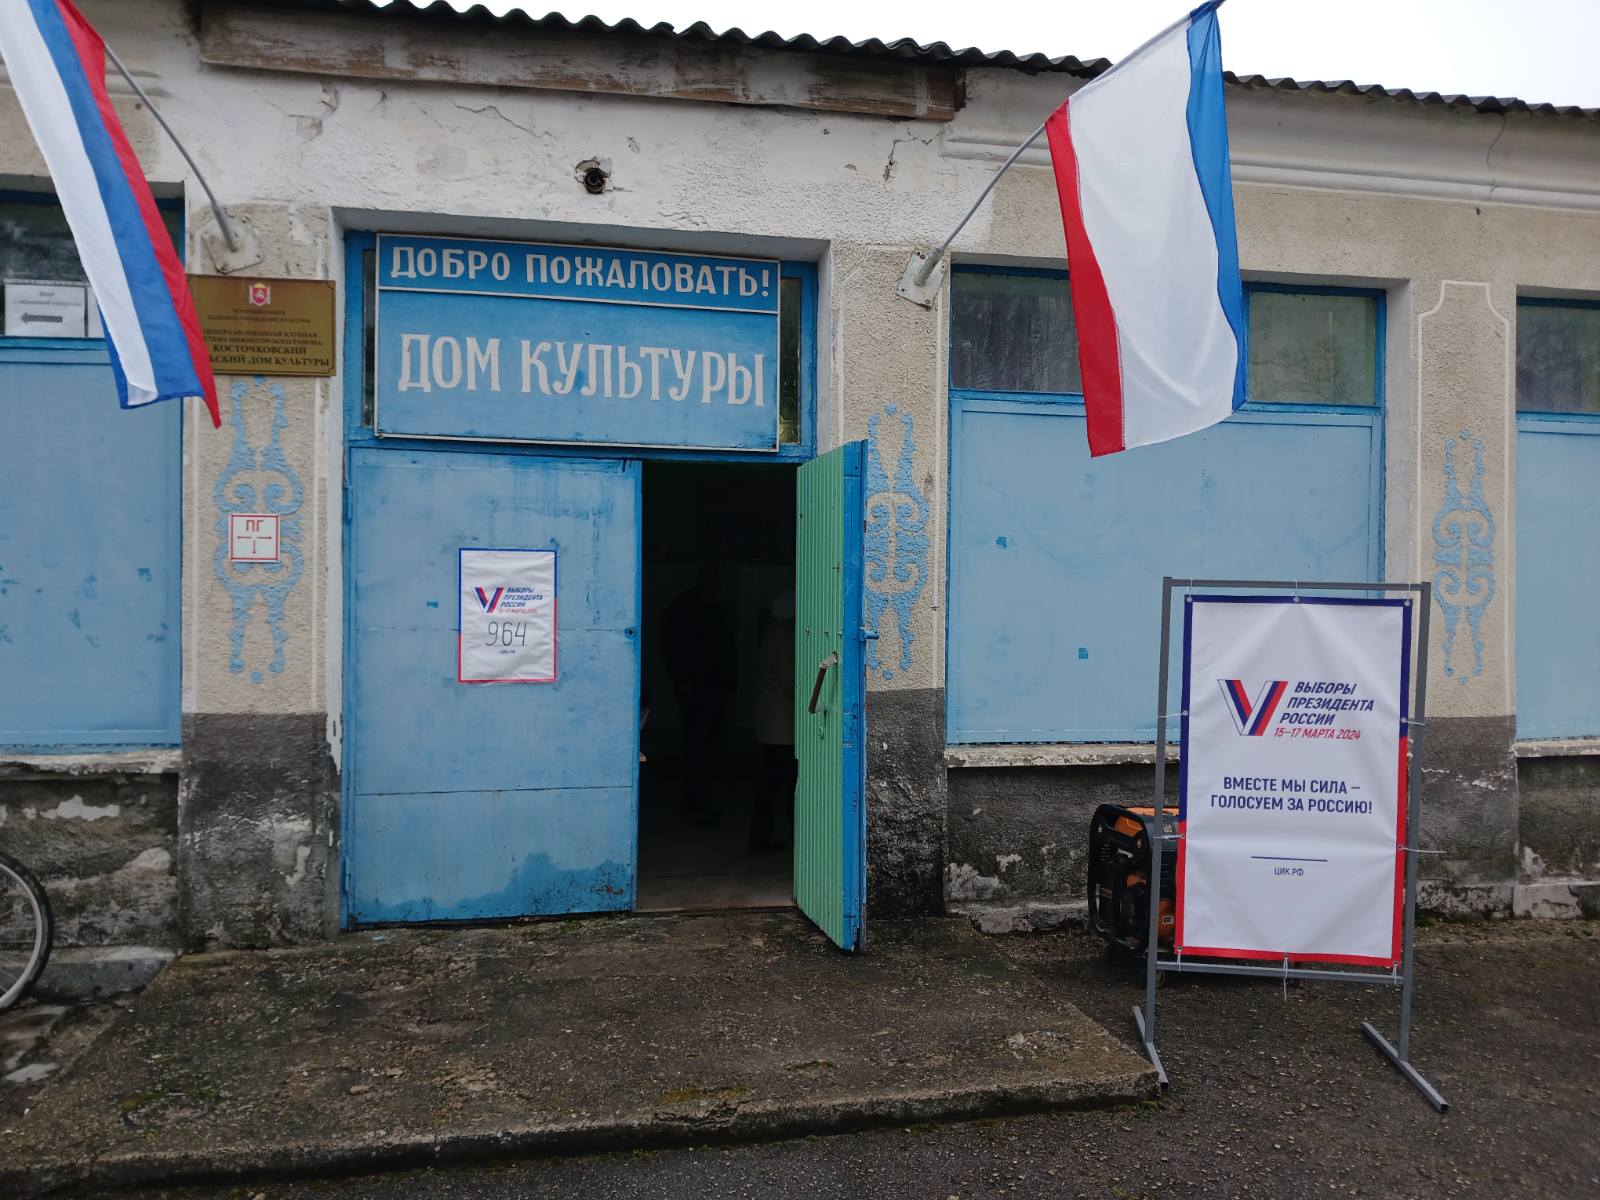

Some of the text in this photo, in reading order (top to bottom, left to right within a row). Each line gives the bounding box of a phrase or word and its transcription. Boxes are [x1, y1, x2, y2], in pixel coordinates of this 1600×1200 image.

[390, 246, 770, 298] ДОБРО ПОЖАЛОВАТЬ!
[248, 355, 272, 366] ДОМ
[275, 356, 329, 367] КУЛЬТУРЫ
[399, 333, 765, 407] ДОМ КУЛЬТУРЫ
[246, 519, 265, 532] ПГ
[485, 621, 527, 647] 964
[1294, 681, 1358, 695] ВЫБОРЫ
[1286, 697, 1375, 712] ПРЕЗИДЕНТА
[1279, 712, 1337, 726] РОССИИ
[1302, 728, 1335, 739] МАРТА
[1336, 729, 1361, 740] 2024
[1223, 776, 1277, 792] ВМЕСТЕ
[1281, 778, 1306, 793] МЫ
[1310, 780, 1348, 794] СИЛА
[1210, 794, 1373, 815] ГОЛОСУЕМ ЗА РОССИЮ!
[1274, 867, 1304, 876] ЦИК.РФ
